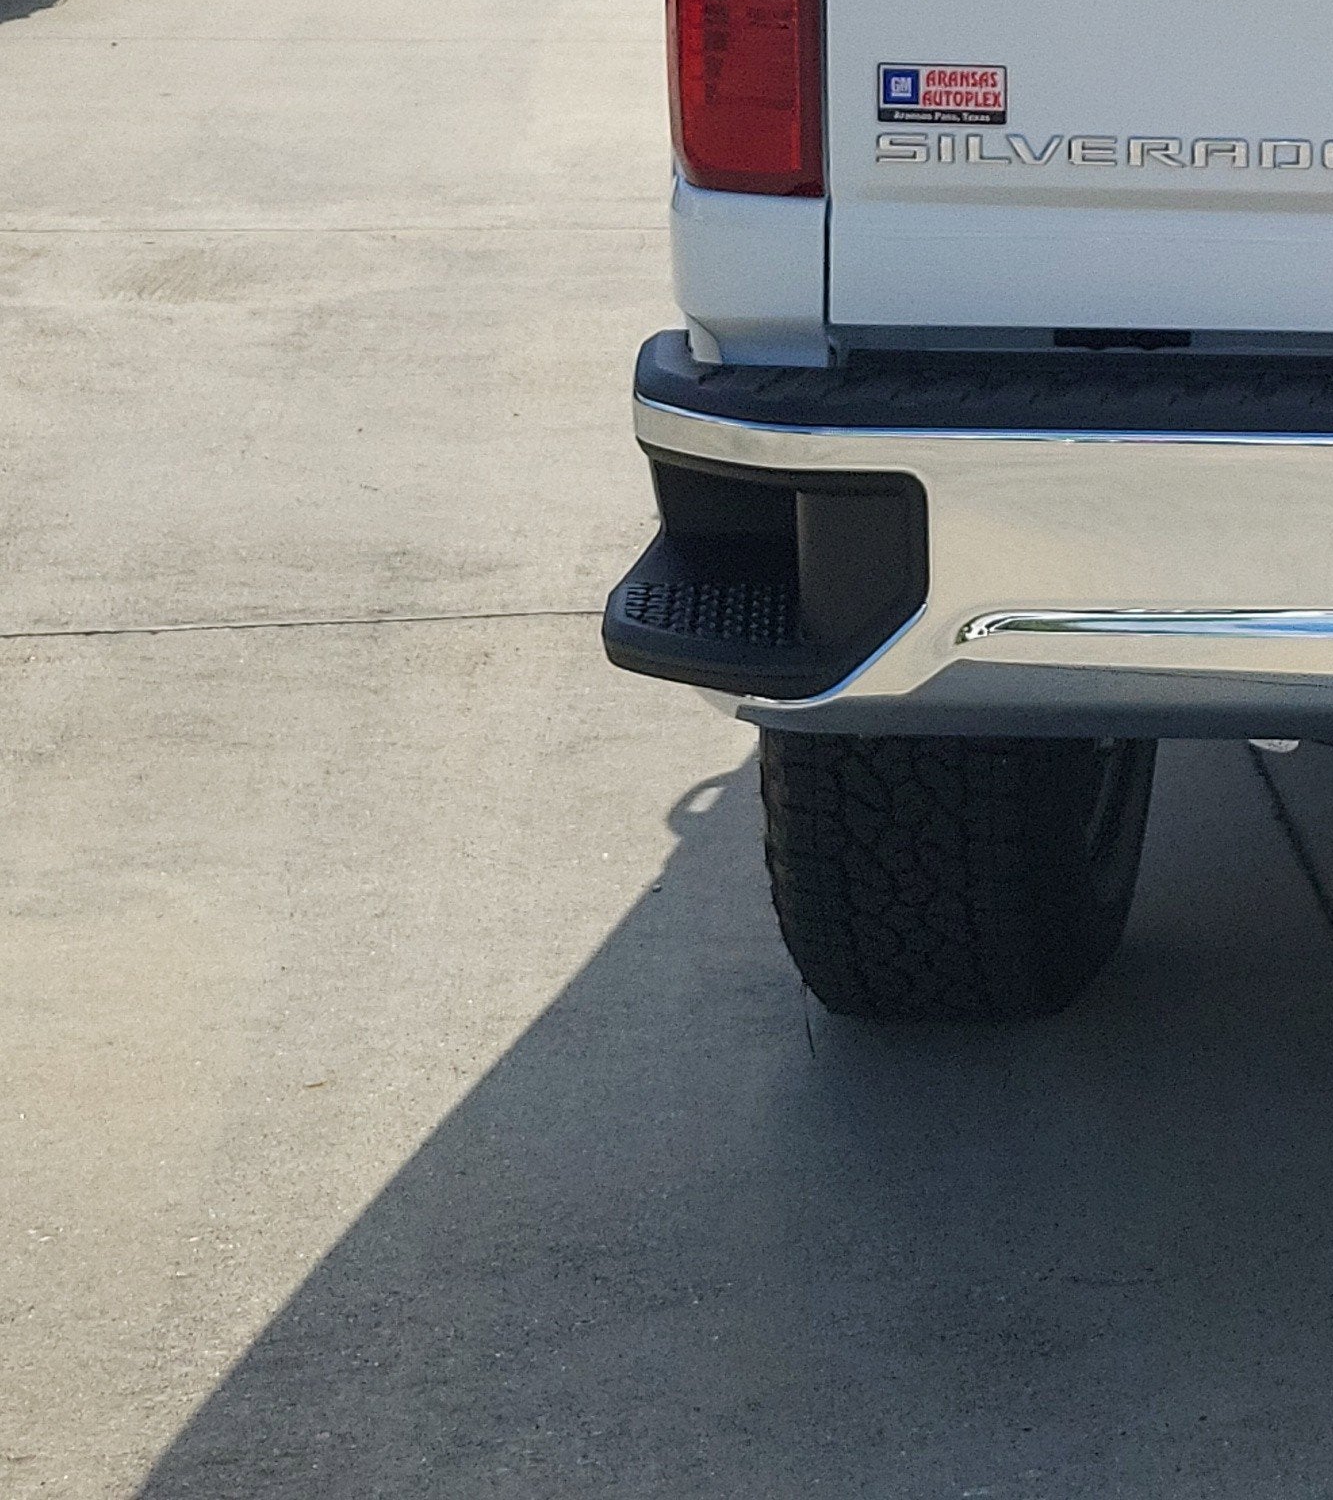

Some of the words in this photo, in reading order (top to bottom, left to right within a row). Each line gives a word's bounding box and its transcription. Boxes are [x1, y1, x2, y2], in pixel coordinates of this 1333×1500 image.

[890, 76, 912, 97] GM
[926, 69, 999, 88] ARANSAS
[922, 90, 1002, 108] AUTOPLEX
[962, 112, 991, 122] Texas
